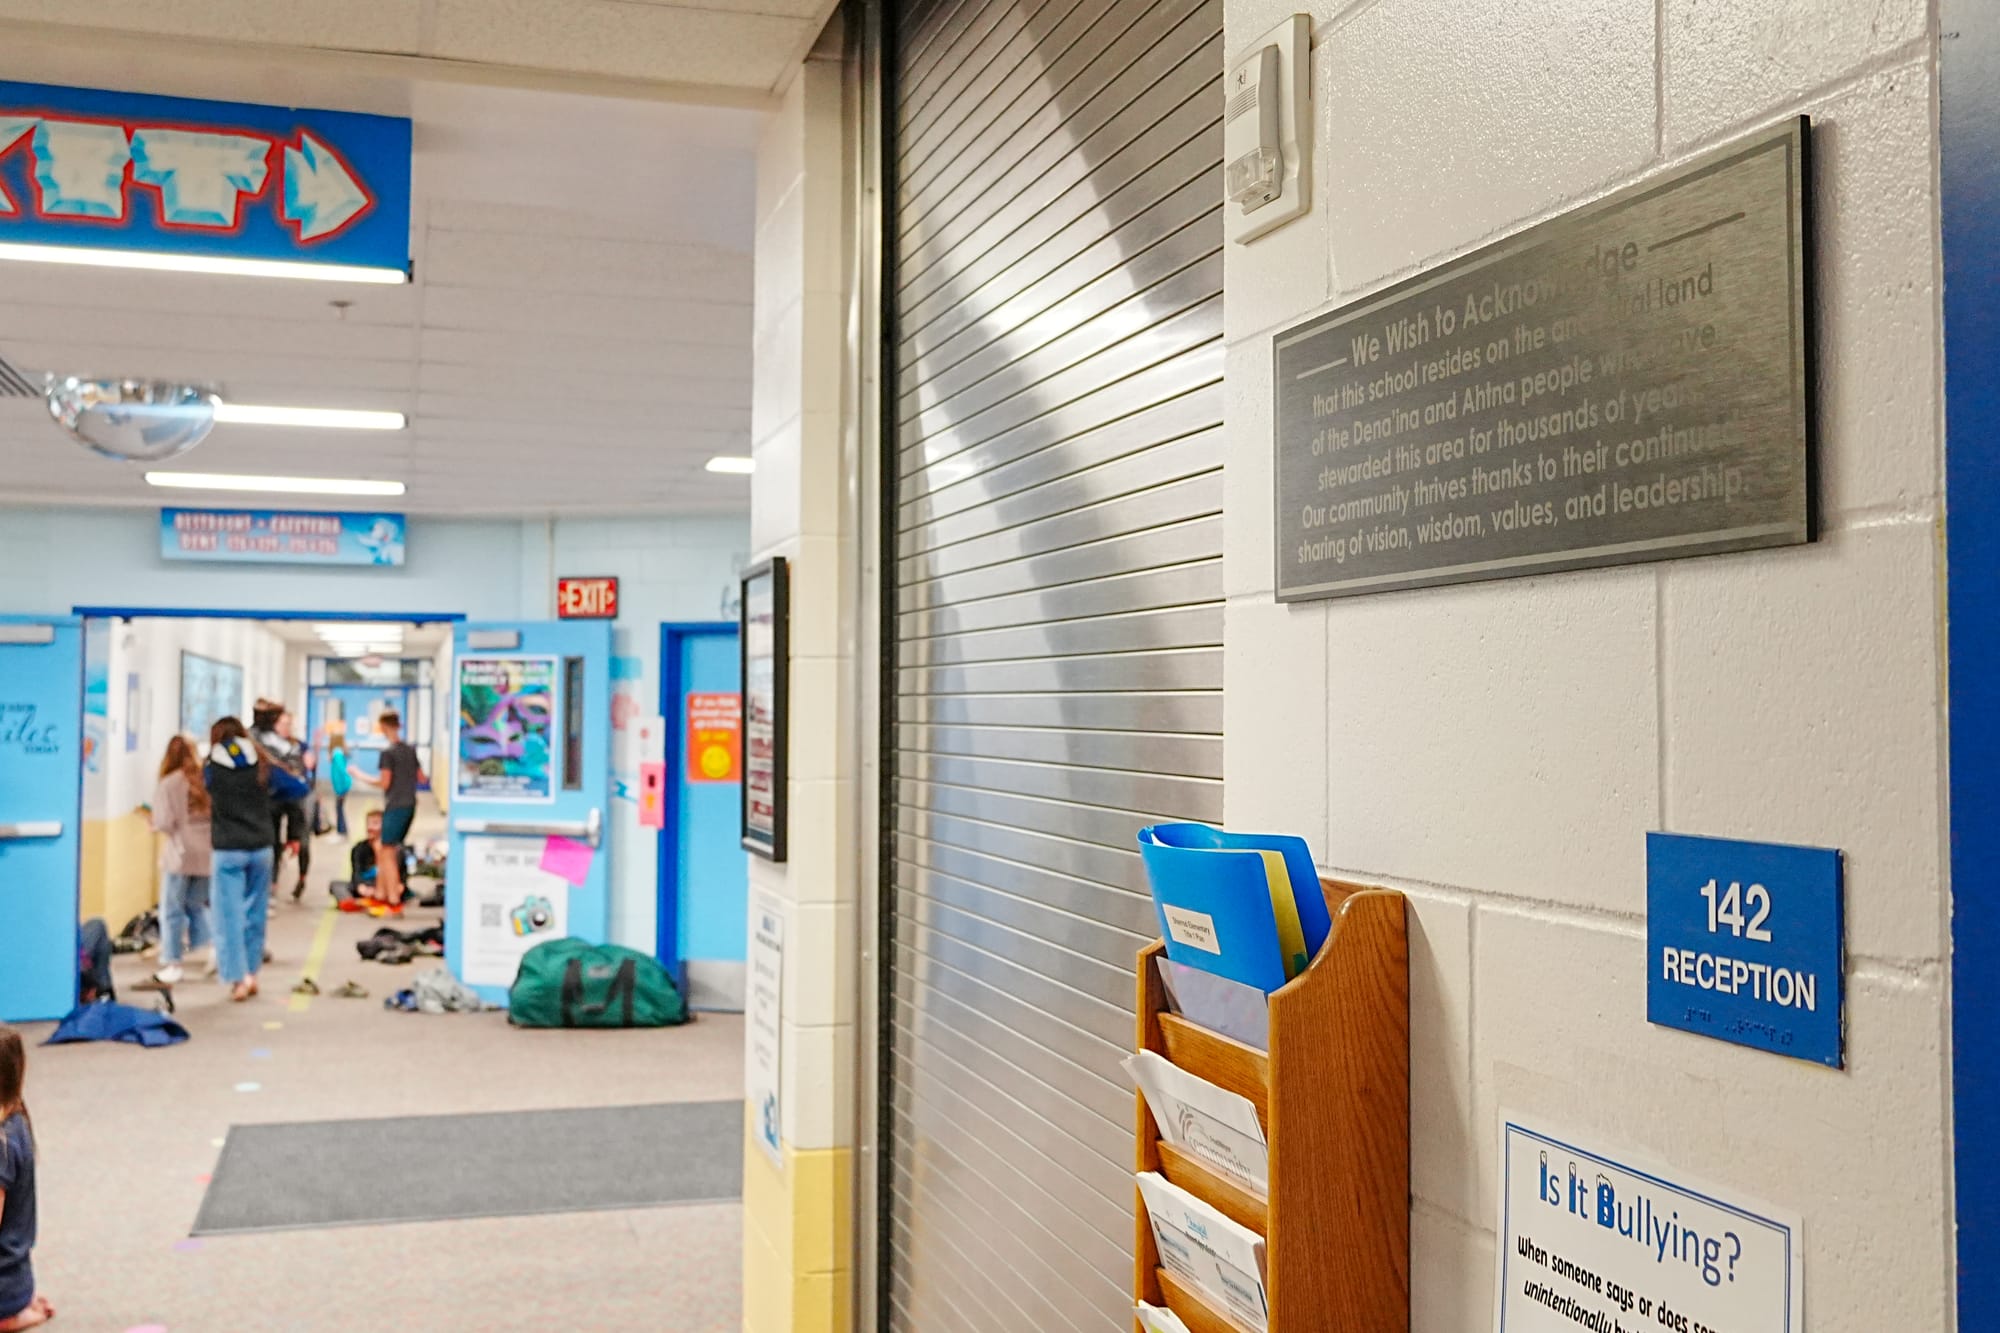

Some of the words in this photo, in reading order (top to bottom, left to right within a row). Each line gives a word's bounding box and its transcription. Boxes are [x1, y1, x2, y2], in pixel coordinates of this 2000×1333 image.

[1313, 391, 1338, 418] that
[1342, 382, 1364, 409] this
[1368, 362, 1418, 401] school
[1422, 344, 1481, 384] resides
[1486, 338, 1509, 365] on
[1515, 323, 1545, 354] the
[1659, 262, 1713, 309] land
[1352, 334, 1380, 367] We
[1386, 312, 1429, 356] Wish
[1435, 305, 1455, 338] to
[1463, 241, 1639, 329] Acknowdge
[1312, 433, 1326, 457] of
[1328, 427, 1349, 450] the
[1353, 408, 1419, 446] Dena'ina
[1424, 392, 1456, 425] and
[1462, 381, 1515, 416] Ahtna
[1521, 354, 1593, 407] people
[1318, 455, 1391, 492] stewarded
[1395, 445, 1421, 473] this
[1425, 439, 1464, 466] area
[1469, 428, 1492, 455] for
[1497, 398, 1599, 445] thousands
[1605, 388, 1627, 423] of
[1298, 537, 1345, 564] sharing
[1349, 530, 1363, 555] of
[1366, 523, 1412, 551] vision,
[1417, 513, 1486, 544] wisdom,
[1491, 500, 1558, 531] values,
[1565, 485, 1606, 521] and
[1302, 505, 1326, 529] Our
[1329, 485, 1410, 523] community
[1414, 476, 1467, 507] thrives
[1471, 459, 1532, 495] thanks
[1537, 454, 1557, 482] to
[1562, 441, 1609, 478] their
[567, 580, 607, 615] EXIT
[1700, 879, 1771, 942] 142
[1663, 946, 1816, 1012] RECEPTION
[1540, 1150, 1560, 1206] Is
[1568, 1161, 1588, 1220] It
[1596, 1173, 1742, 1287] Bullying?
[1524, 1280, 1612, 1333] unintentionally
[1552, 1254, 1602, 1293] someone
[1607, 1280, 1634, 1312] says
[1639, 1297, 1653, 1317] or
[1657, 1300, 1688, 1333] does
